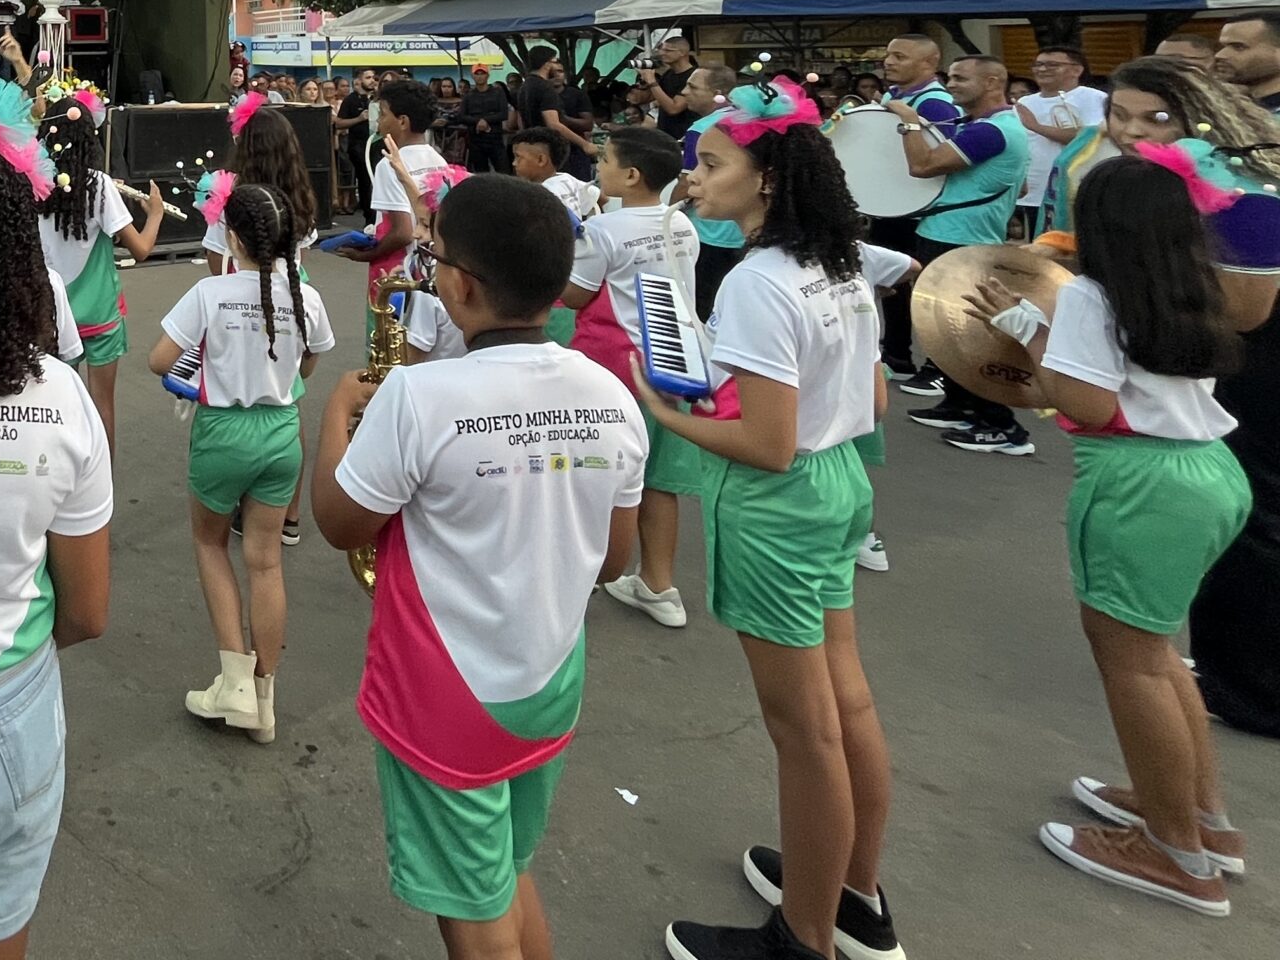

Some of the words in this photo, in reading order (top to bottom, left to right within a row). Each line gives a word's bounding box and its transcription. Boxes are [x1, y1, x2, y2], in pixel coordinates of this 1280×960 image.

[351, 42, 392, 50] CAMINHO
[395, 42, 407, 50] DA
[408, 42, 439, 50] SORTE
[218, 302, 249, 311] PROJETO
[455, 413, 522, 435] PROJETO
[525, 408, 572, 427] MINHA
[574, 407, 627, 424] PRIMEIRA
[508, 429, 541, 448] OPÇÃO
[547, 426, 600, 443] EDUCAÇÃO
[974, 432, 1008, 442] FILA
